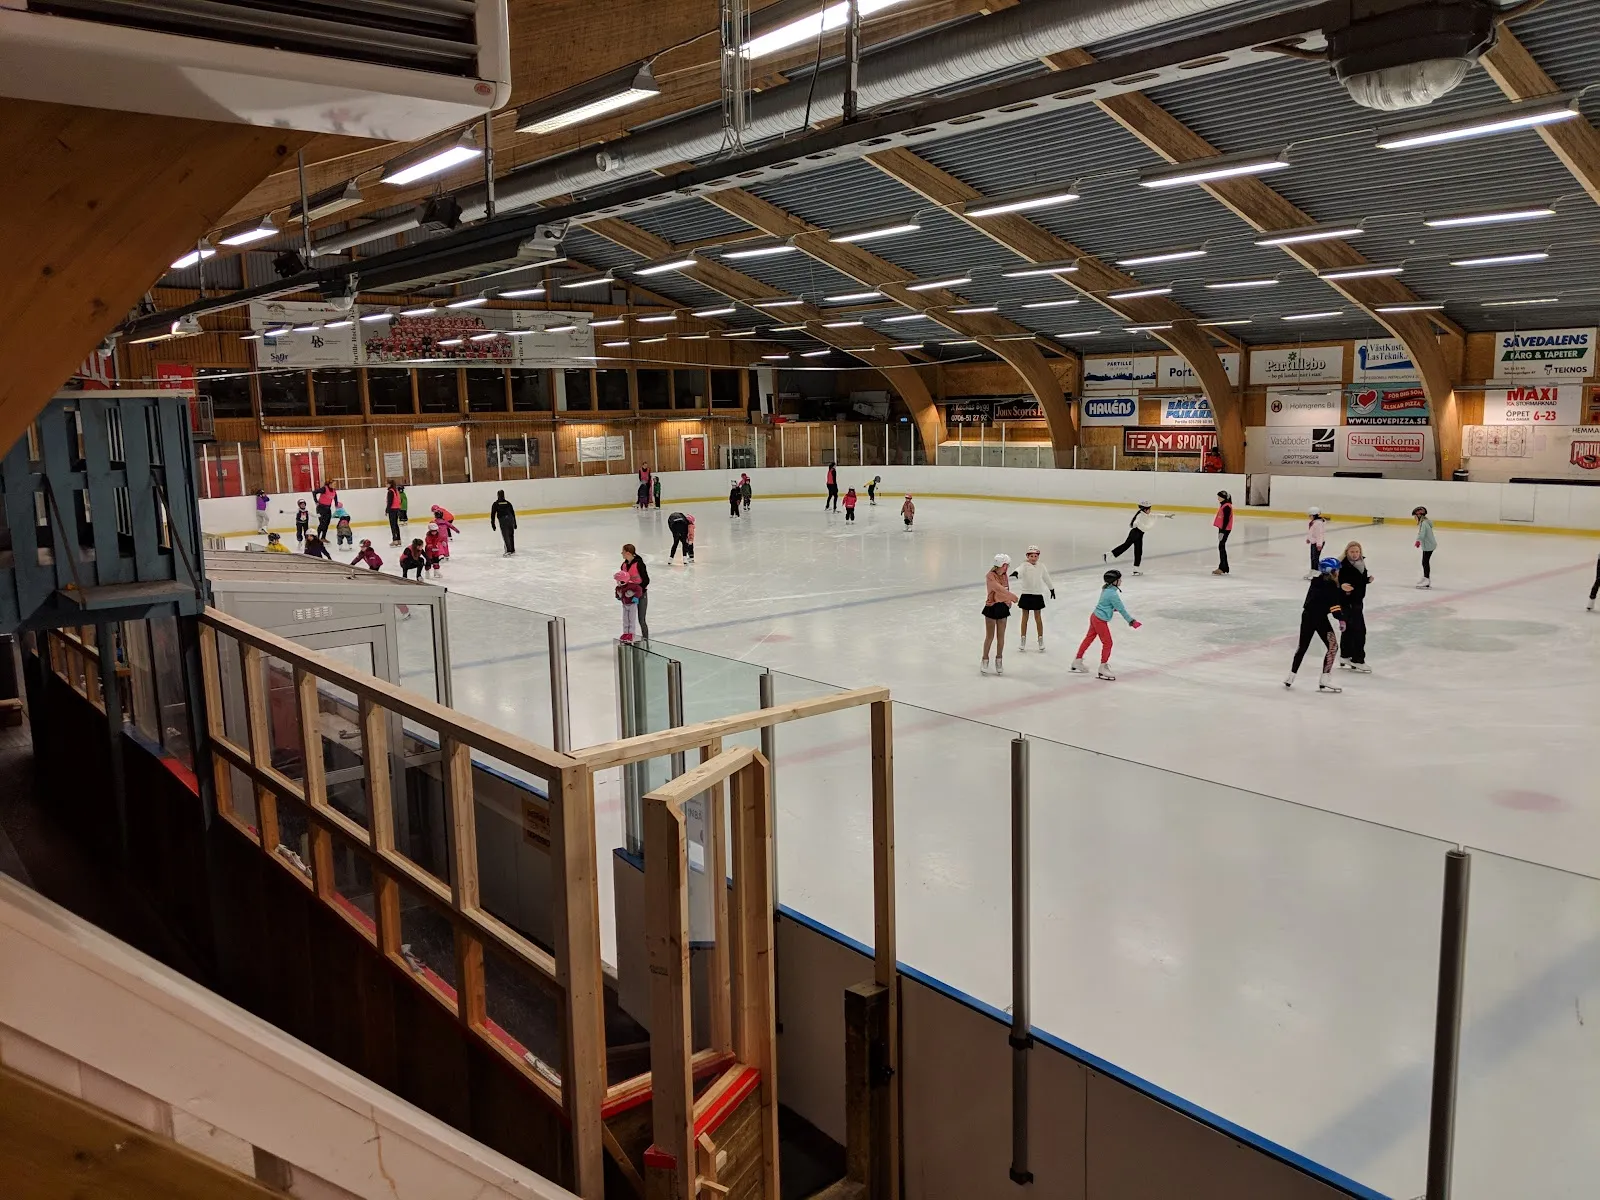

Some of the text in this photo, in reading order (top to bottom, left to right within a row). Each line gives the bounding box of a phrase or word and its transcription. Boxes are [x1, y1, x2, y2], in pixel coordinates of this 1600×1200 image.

[1503, 333, 1588, 348] SÄVEDALENS
[1510, 351, 1533, 359] FÄRG
[1544, 350, 1578, 358] TAPETER
[1265, 358, 1326, 373] Partillebo
[1554, 366, 1588, 374] TEKNOS
[1388, 391, 1399, 399] FÖR
[1410, 388, 1423, 396] SOM
[1507, 386, 1558, 401] MAXI
[1289, 402, 1326, 411] Holmgrens
[1326, 401, 1336, 409] Bil
[1383, 400, 1421, 410] ÄLSKAR PIZZA
[1166, 410, 1213, 419] POJKARN
[1533, 411, 1556, 421] 6-23
[1348, 417, 1427, 425] WWW.ILOVEPIZZA.SE
[1128, 434, 1218, 450] TEAM SPORTIA
[1270, 436, 1310, 445] Vasaboden
[1351, 436, 1420, 445] Skurflickorna
[1574, 442, 1600, 461] PARTIL
